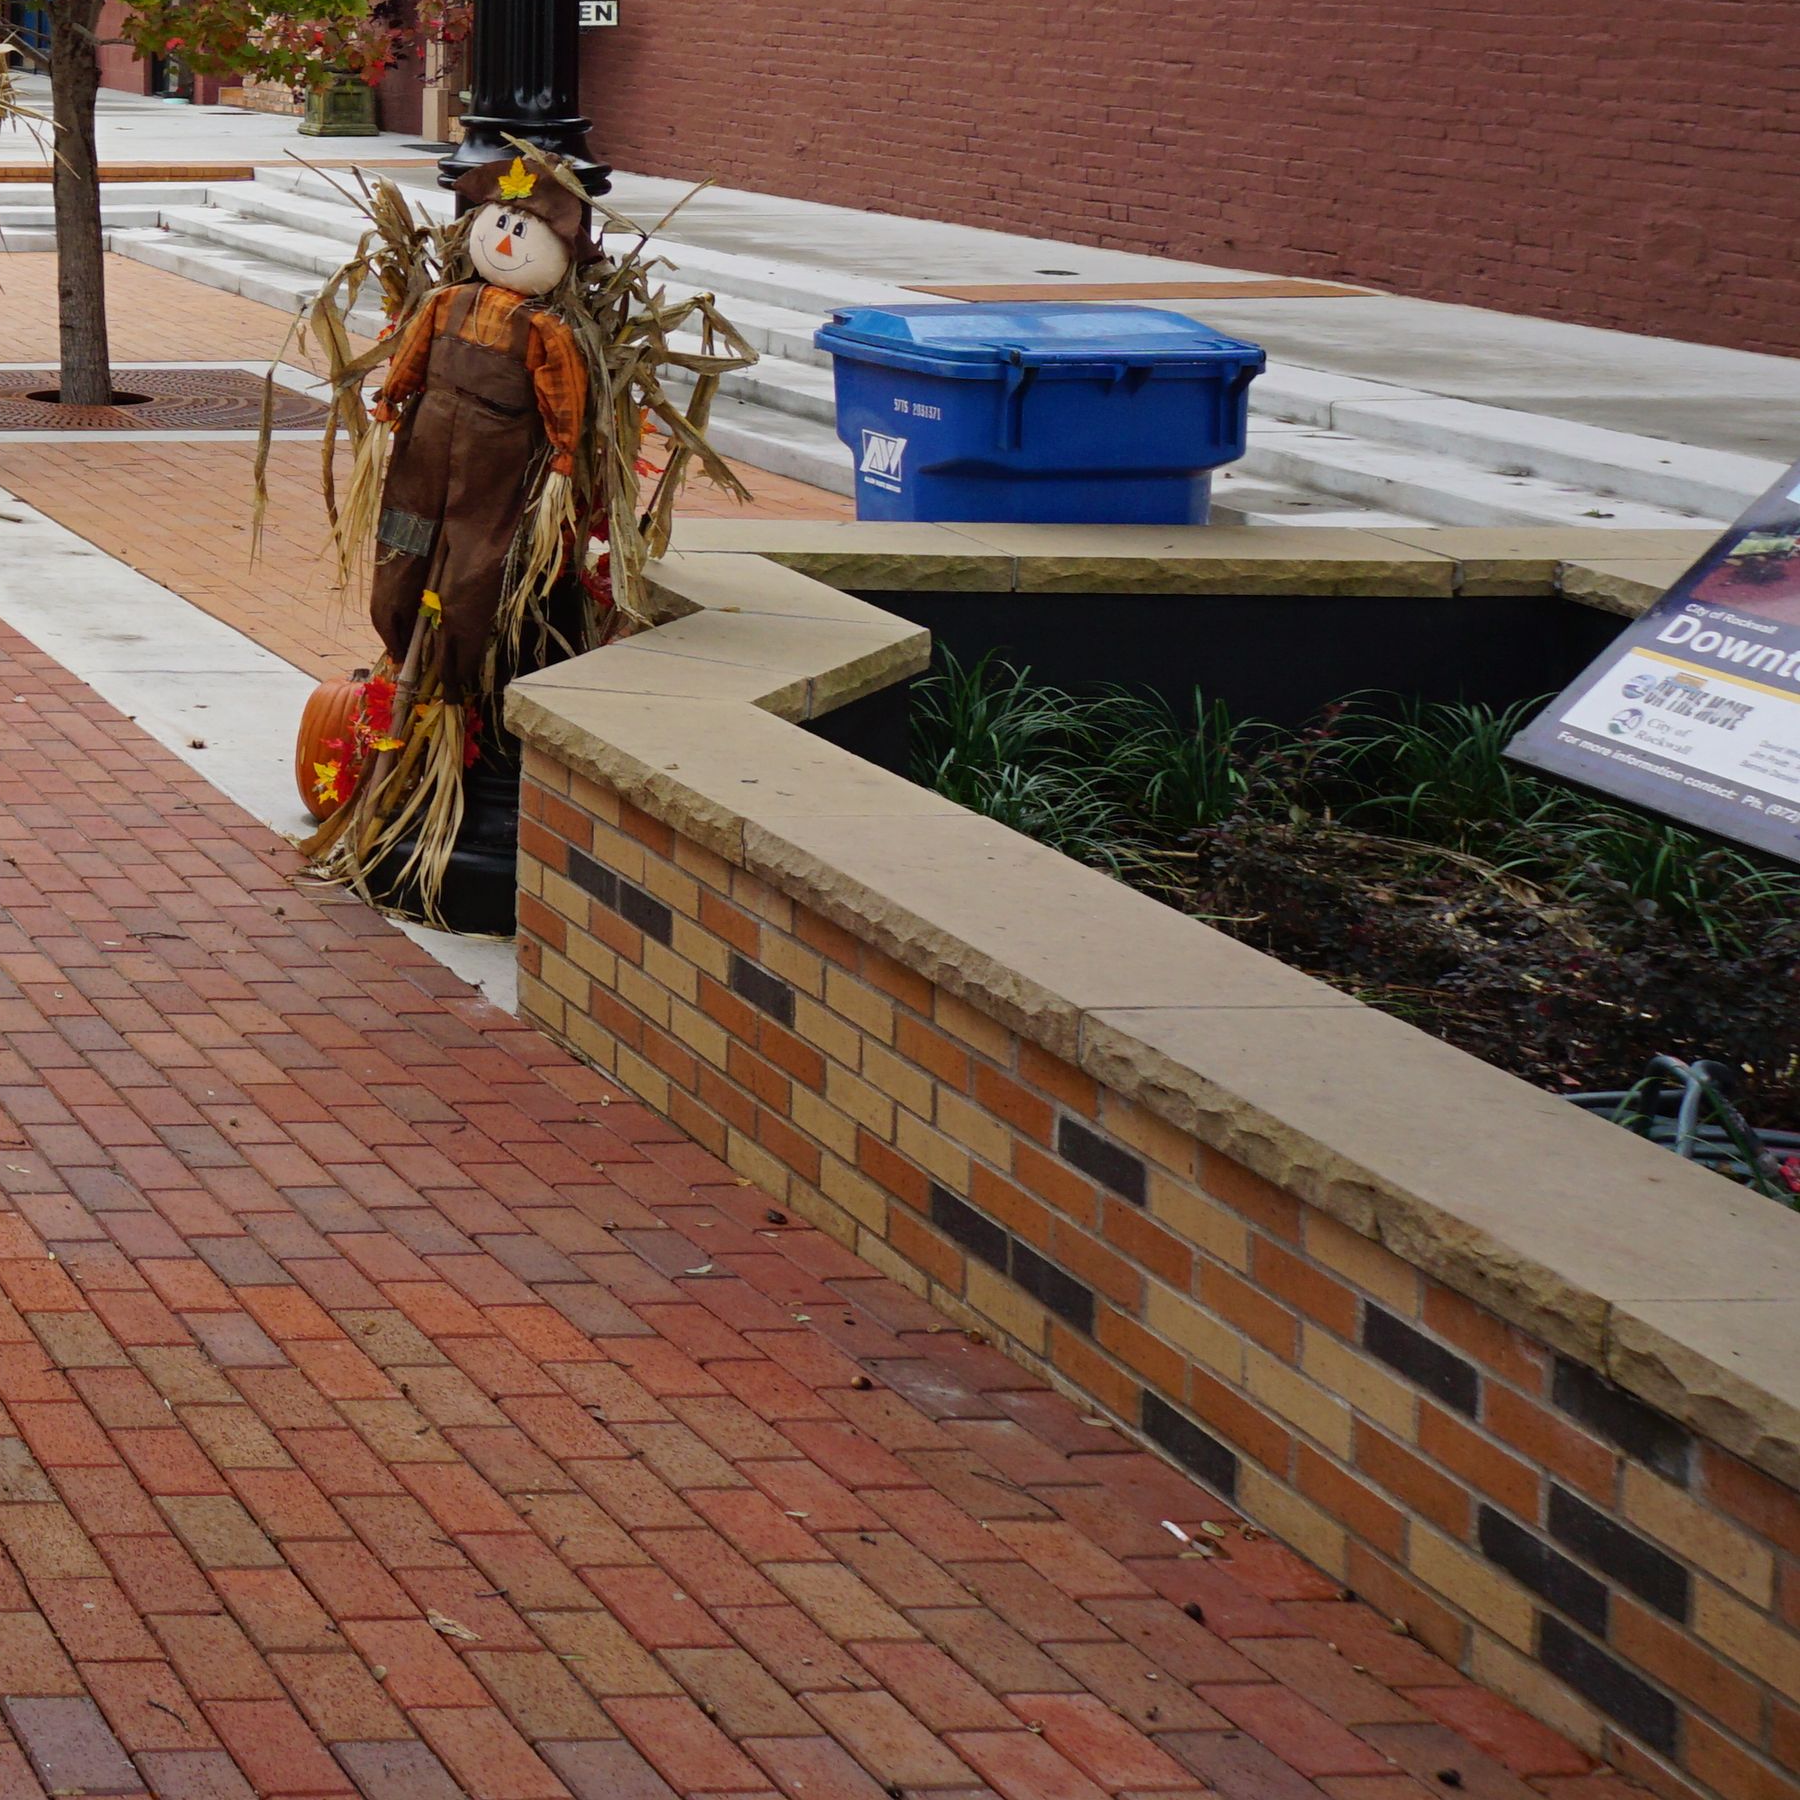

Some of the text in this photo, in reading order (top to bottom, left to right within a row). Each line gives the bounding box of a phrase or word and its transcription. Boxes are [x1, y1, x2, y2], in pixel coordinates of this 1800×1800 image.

[1685, 603, 1779, 635] City of Rockwall
[1656, 614, 1800, 683] Downt
[1634, 730, 1695, 756] Rockwall
[1647, 718, 1694, 739] City of
[1556, 731, 1580, 746] For
[1579, 740, 1612, 757] more
[1611, 750, 1684, 782] information
[1683, 774, 1739, 801] contact:
[1741, 794, 1764, 811] Ph.
